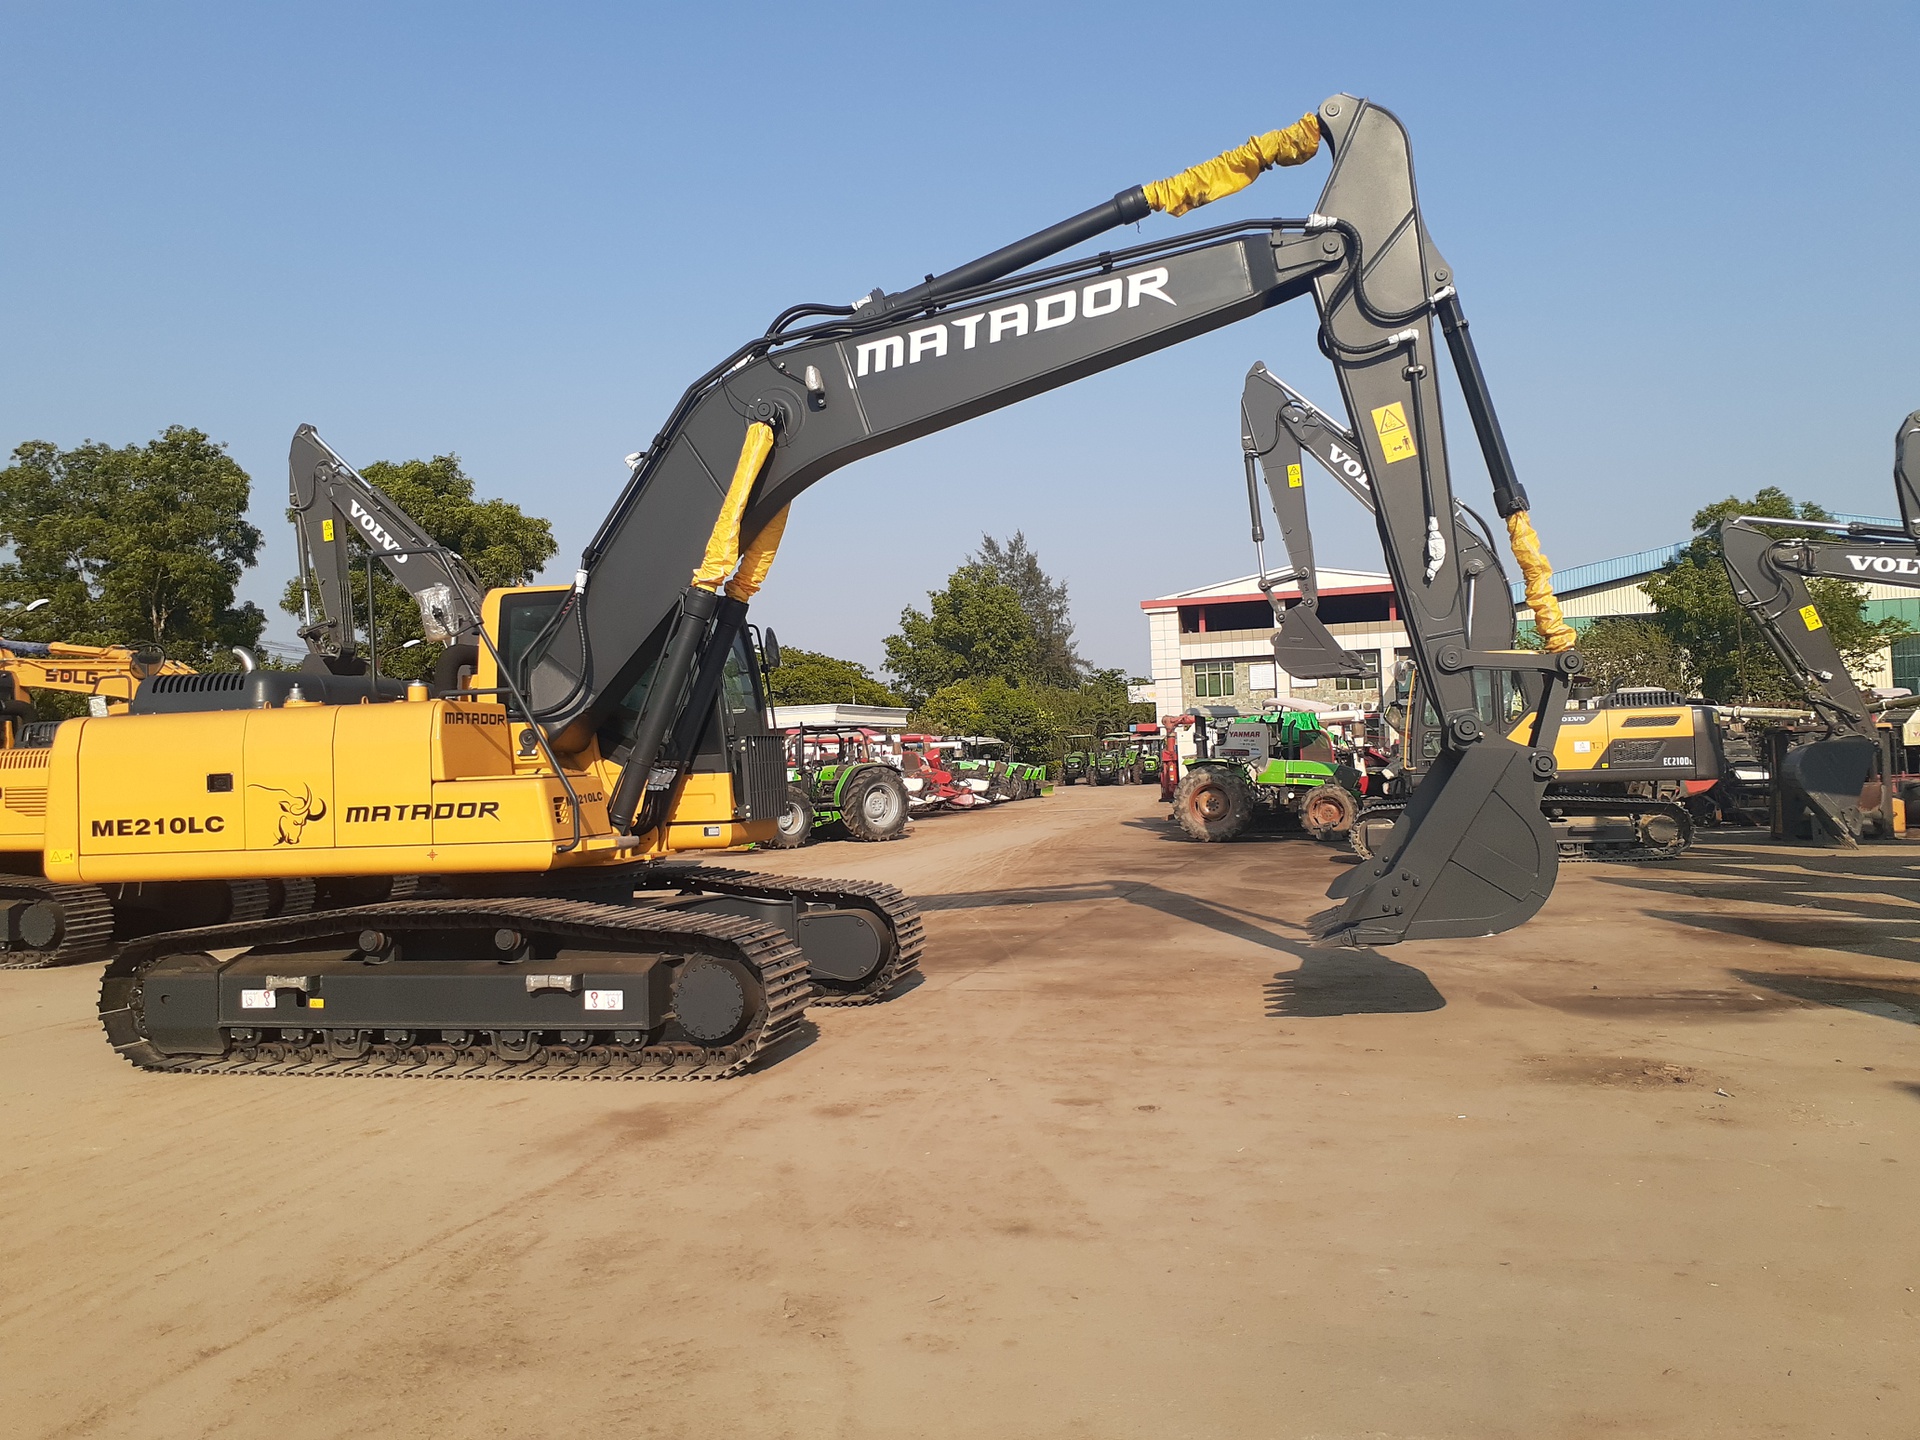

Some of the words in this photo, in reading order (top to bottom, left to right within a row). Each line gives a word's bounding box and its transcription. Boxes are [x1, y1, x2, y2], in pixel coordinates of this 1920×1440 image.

[856, 267, 1177, 377] MATADOR
[1329, 443, 1371, 491] VOL
[1845, 554, 1920, 575] VOL
[45, 669, 98, 685] SDLG
[445, 712, 506, 728] MATADOR
[566, 791, 603, 807] M210LC
[345, 801, 501, 823] MATADOR
[91, 815, 225, 837] ME210LC
